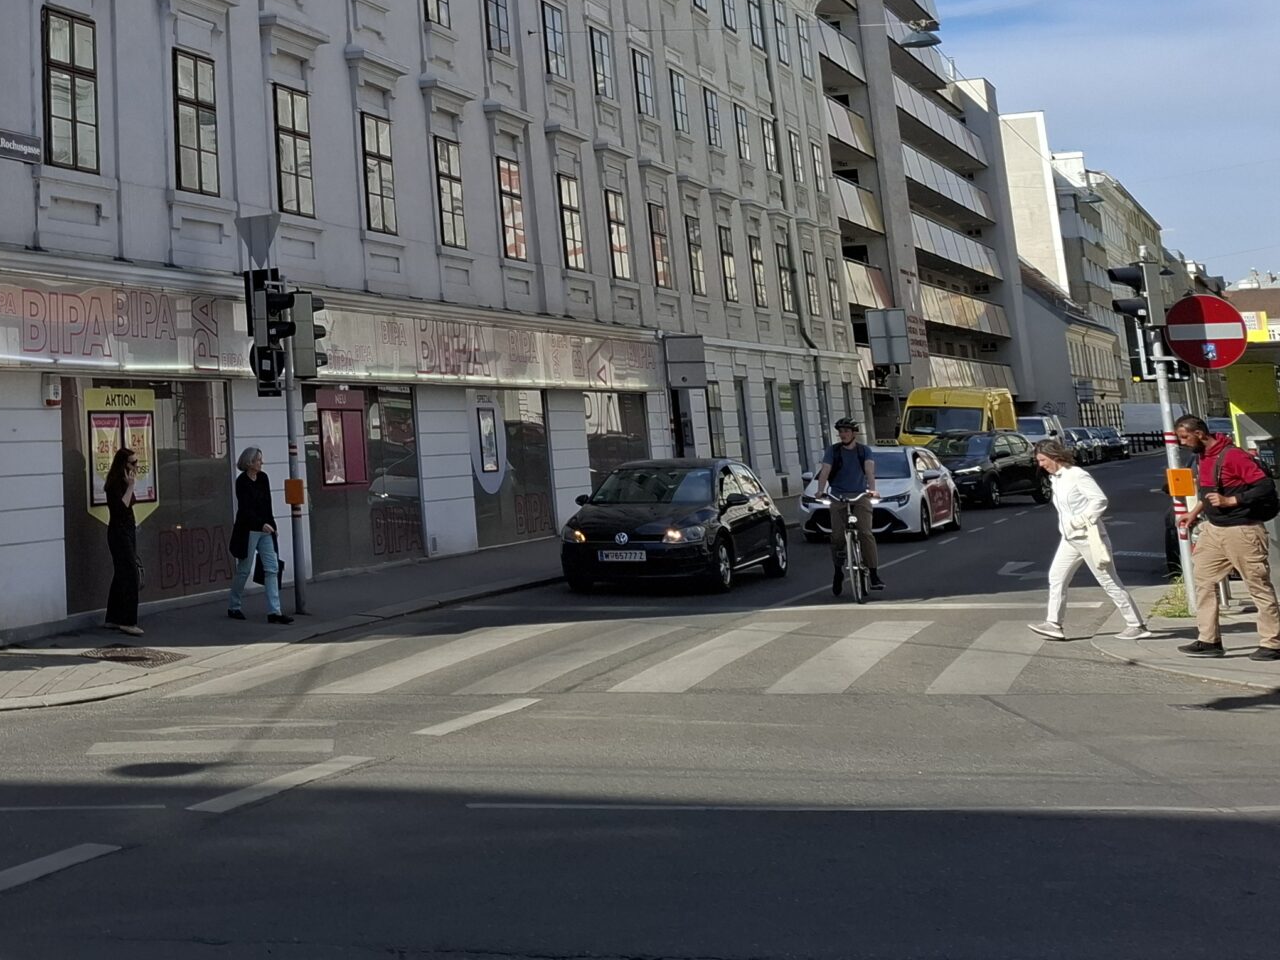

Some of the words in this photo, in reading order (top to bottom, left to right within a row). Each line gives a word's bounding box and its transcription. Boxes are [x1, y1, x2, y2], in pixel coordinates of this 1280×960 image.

[22, 289, 112, 357] BIPA
[112, 289, 176, 340] BIPA
[381, 321, 407, 346] BIPA
[508, 330, 540, 364] BIPA
[105, 394, 136, 407] AKTION
[334, 395, 347, 404] NEU
[372, 506, 424, 556] BIPA
[515, 493, 555, 535] BIPA
[159, 526, 233, 589] BIPA
